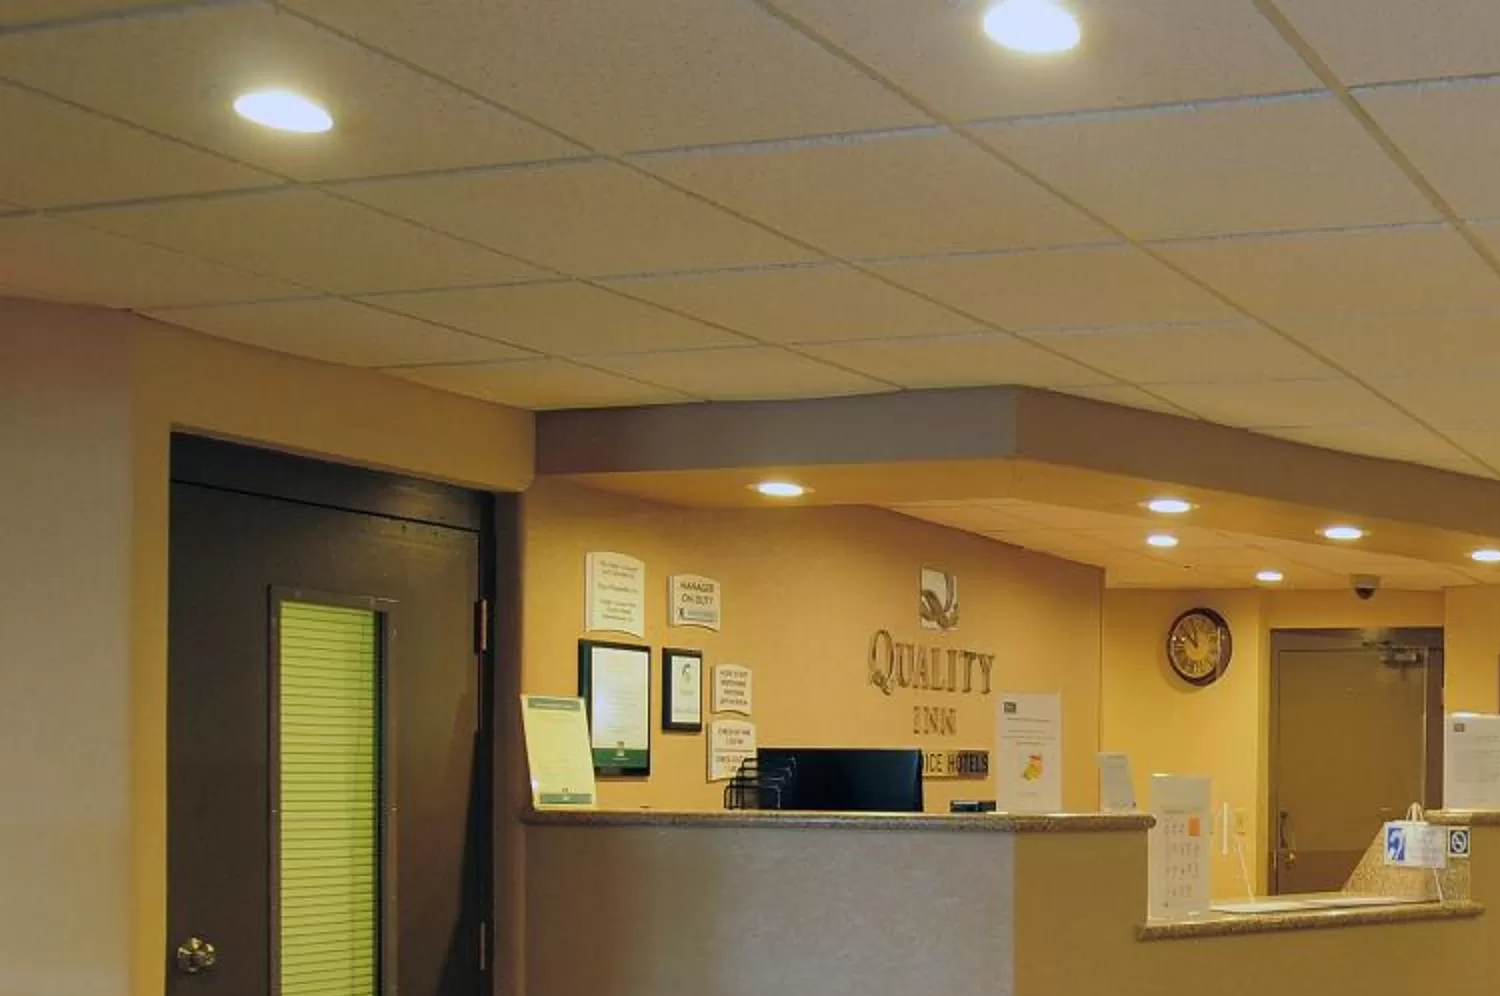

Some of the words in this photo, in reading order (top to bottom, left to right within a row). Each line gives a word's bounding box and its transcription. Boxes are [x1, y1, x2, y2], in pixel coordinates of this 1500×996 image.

[868, 628, 996, 696] QUALITY
[912, 705, 957, 737] INN
[925, 752, 944, 774] ICE
[946, 752, 989, 775] HOTELS
